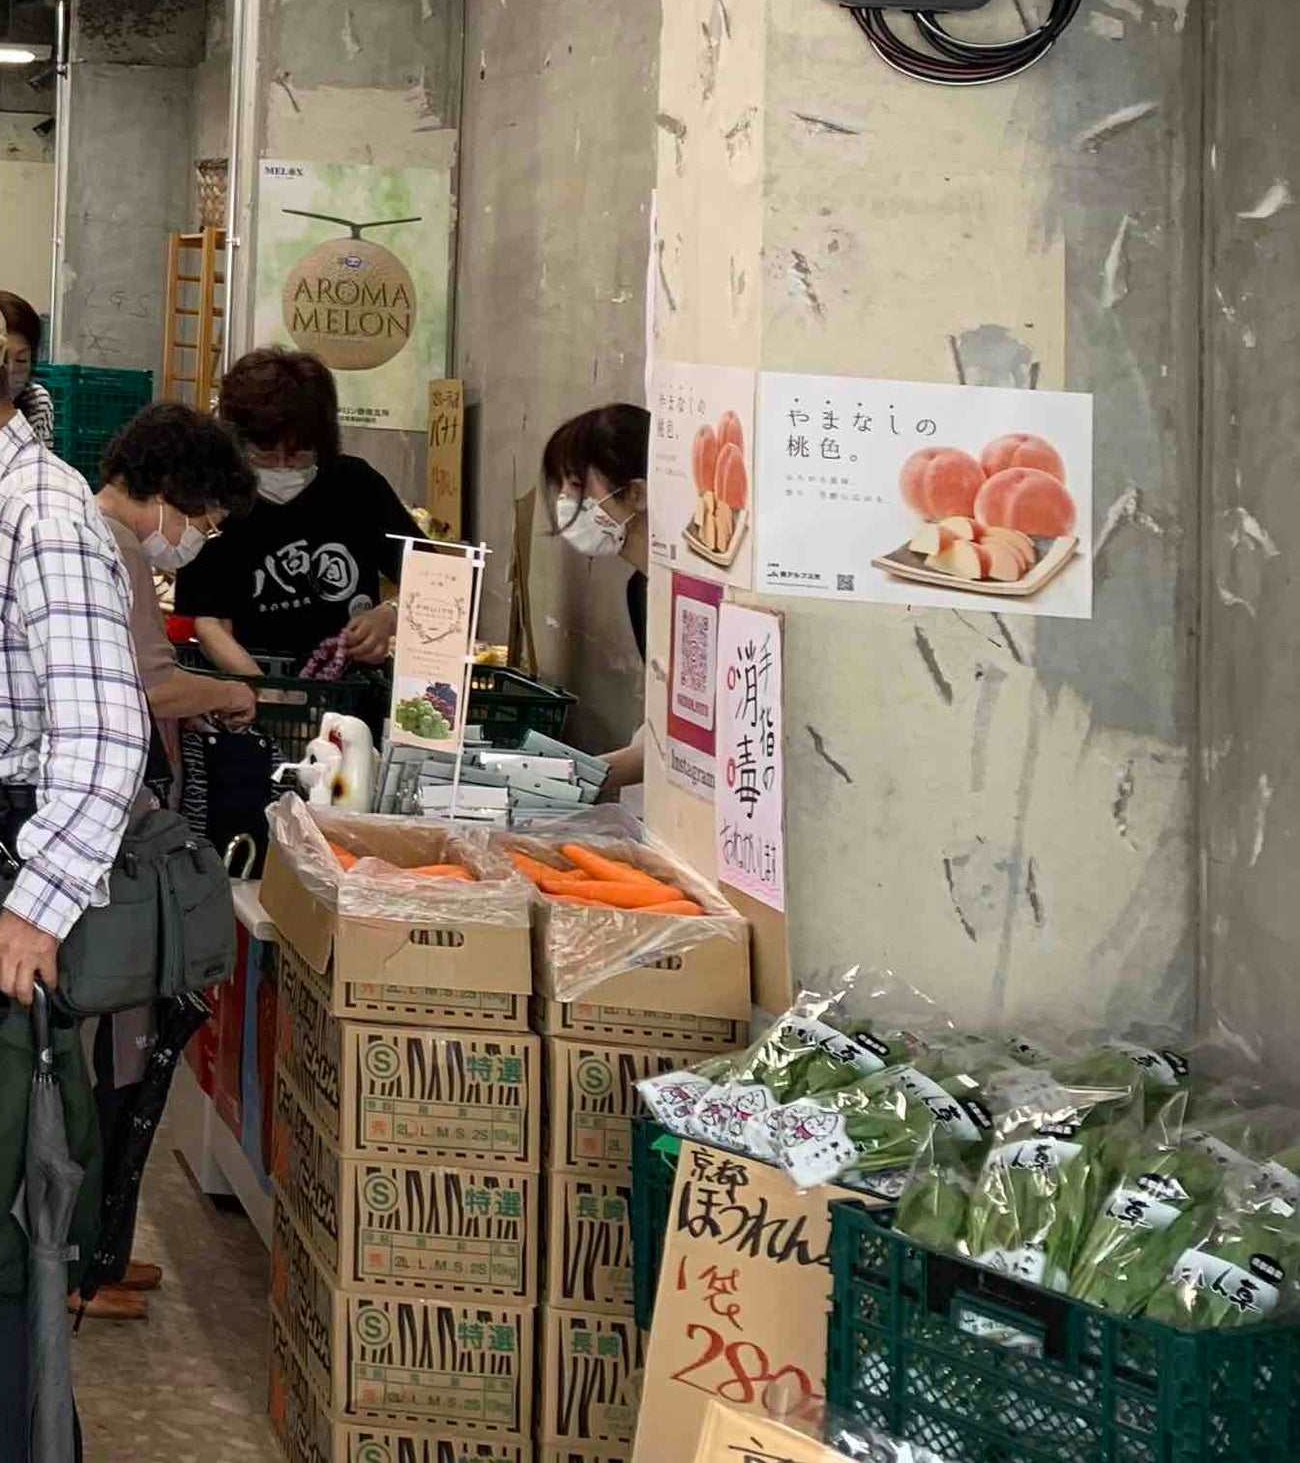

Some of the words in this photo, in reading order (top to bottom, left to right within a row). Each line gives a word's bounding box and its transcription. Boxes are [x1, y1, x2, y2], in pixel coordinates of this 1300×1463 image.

[293, 277, 411, 309] AROMA
[291, 307, 411, 339] MELON
[787, 407, 937, 437] やまなしの
[786, 434, 858, 463] 桃色。
[253, 539, 355, 599] 八百旬
[759, 632, 776, 790] 手指の
[735, 638, 761, 820] 消毒
[671, 747, 715, 790] Instagram
[466, 1055, 524, 1084] 特選
[690, 1148, 749, 1194] 京都
[463, 1188, 522, 1217] 特選
[574, 1195, 626, 1223] 長崎
[457, 1321, 516, 1352] 特選
[570, 1329, 622, 1357] 長崎
